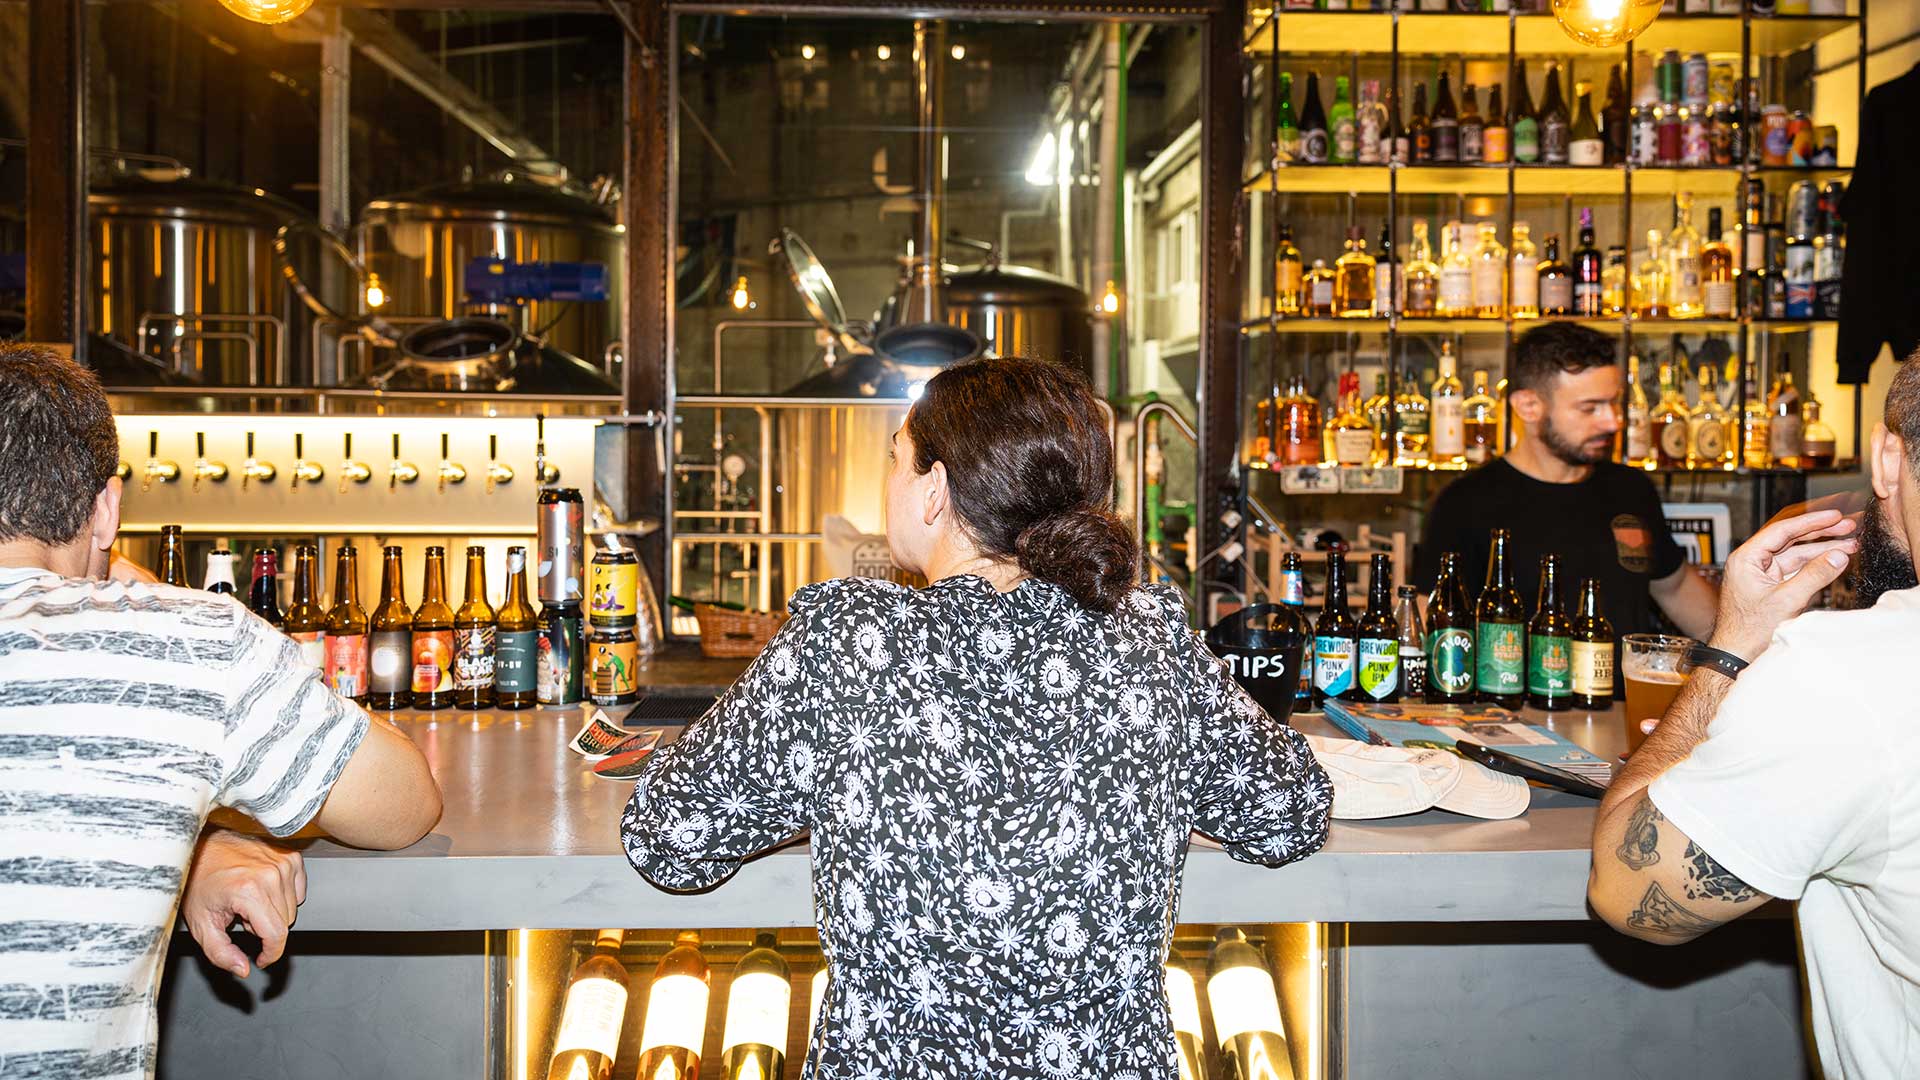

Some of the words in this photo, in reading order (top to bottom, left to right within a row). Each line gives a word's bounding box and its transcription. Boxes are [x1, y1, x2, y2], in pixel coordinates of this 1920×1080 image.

[457, 656, 495, 668] BLACK
[1222, 654, 1285, 679] TIPS
[1321, 659, 1344, 671] PUNK
[1367, 662, 1390, 673] PUNK
[461, 665, 493, 679] STAR
[1326, 671, 1339, 681] IPA
[1372, 673, 1385, 683] IPA
